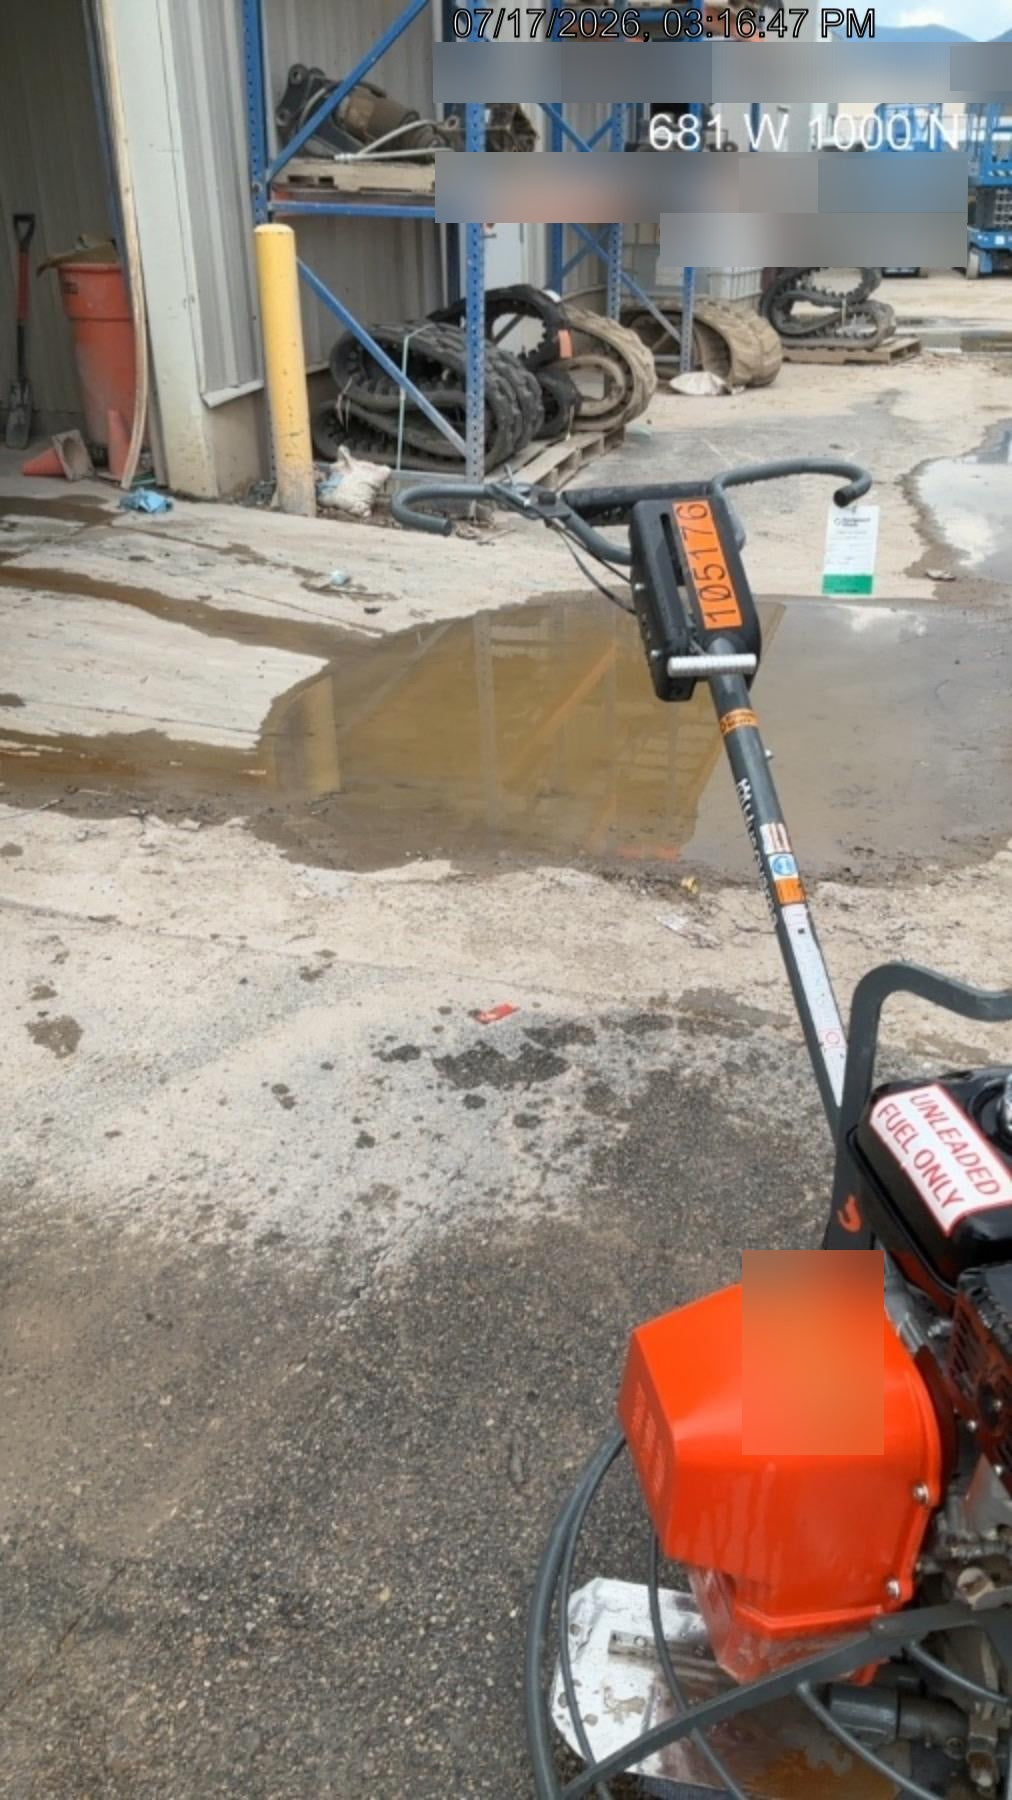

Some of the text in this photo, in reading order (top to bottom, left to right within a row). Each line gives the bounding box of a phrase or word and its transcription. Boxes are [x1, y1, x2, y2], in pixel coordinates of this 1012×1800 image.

[675, 502, 737, 624] 105176
[877, 1102, 965, 1208] FUEL ONLY
[909, 1093, 1001, 1196] UNLEADED
